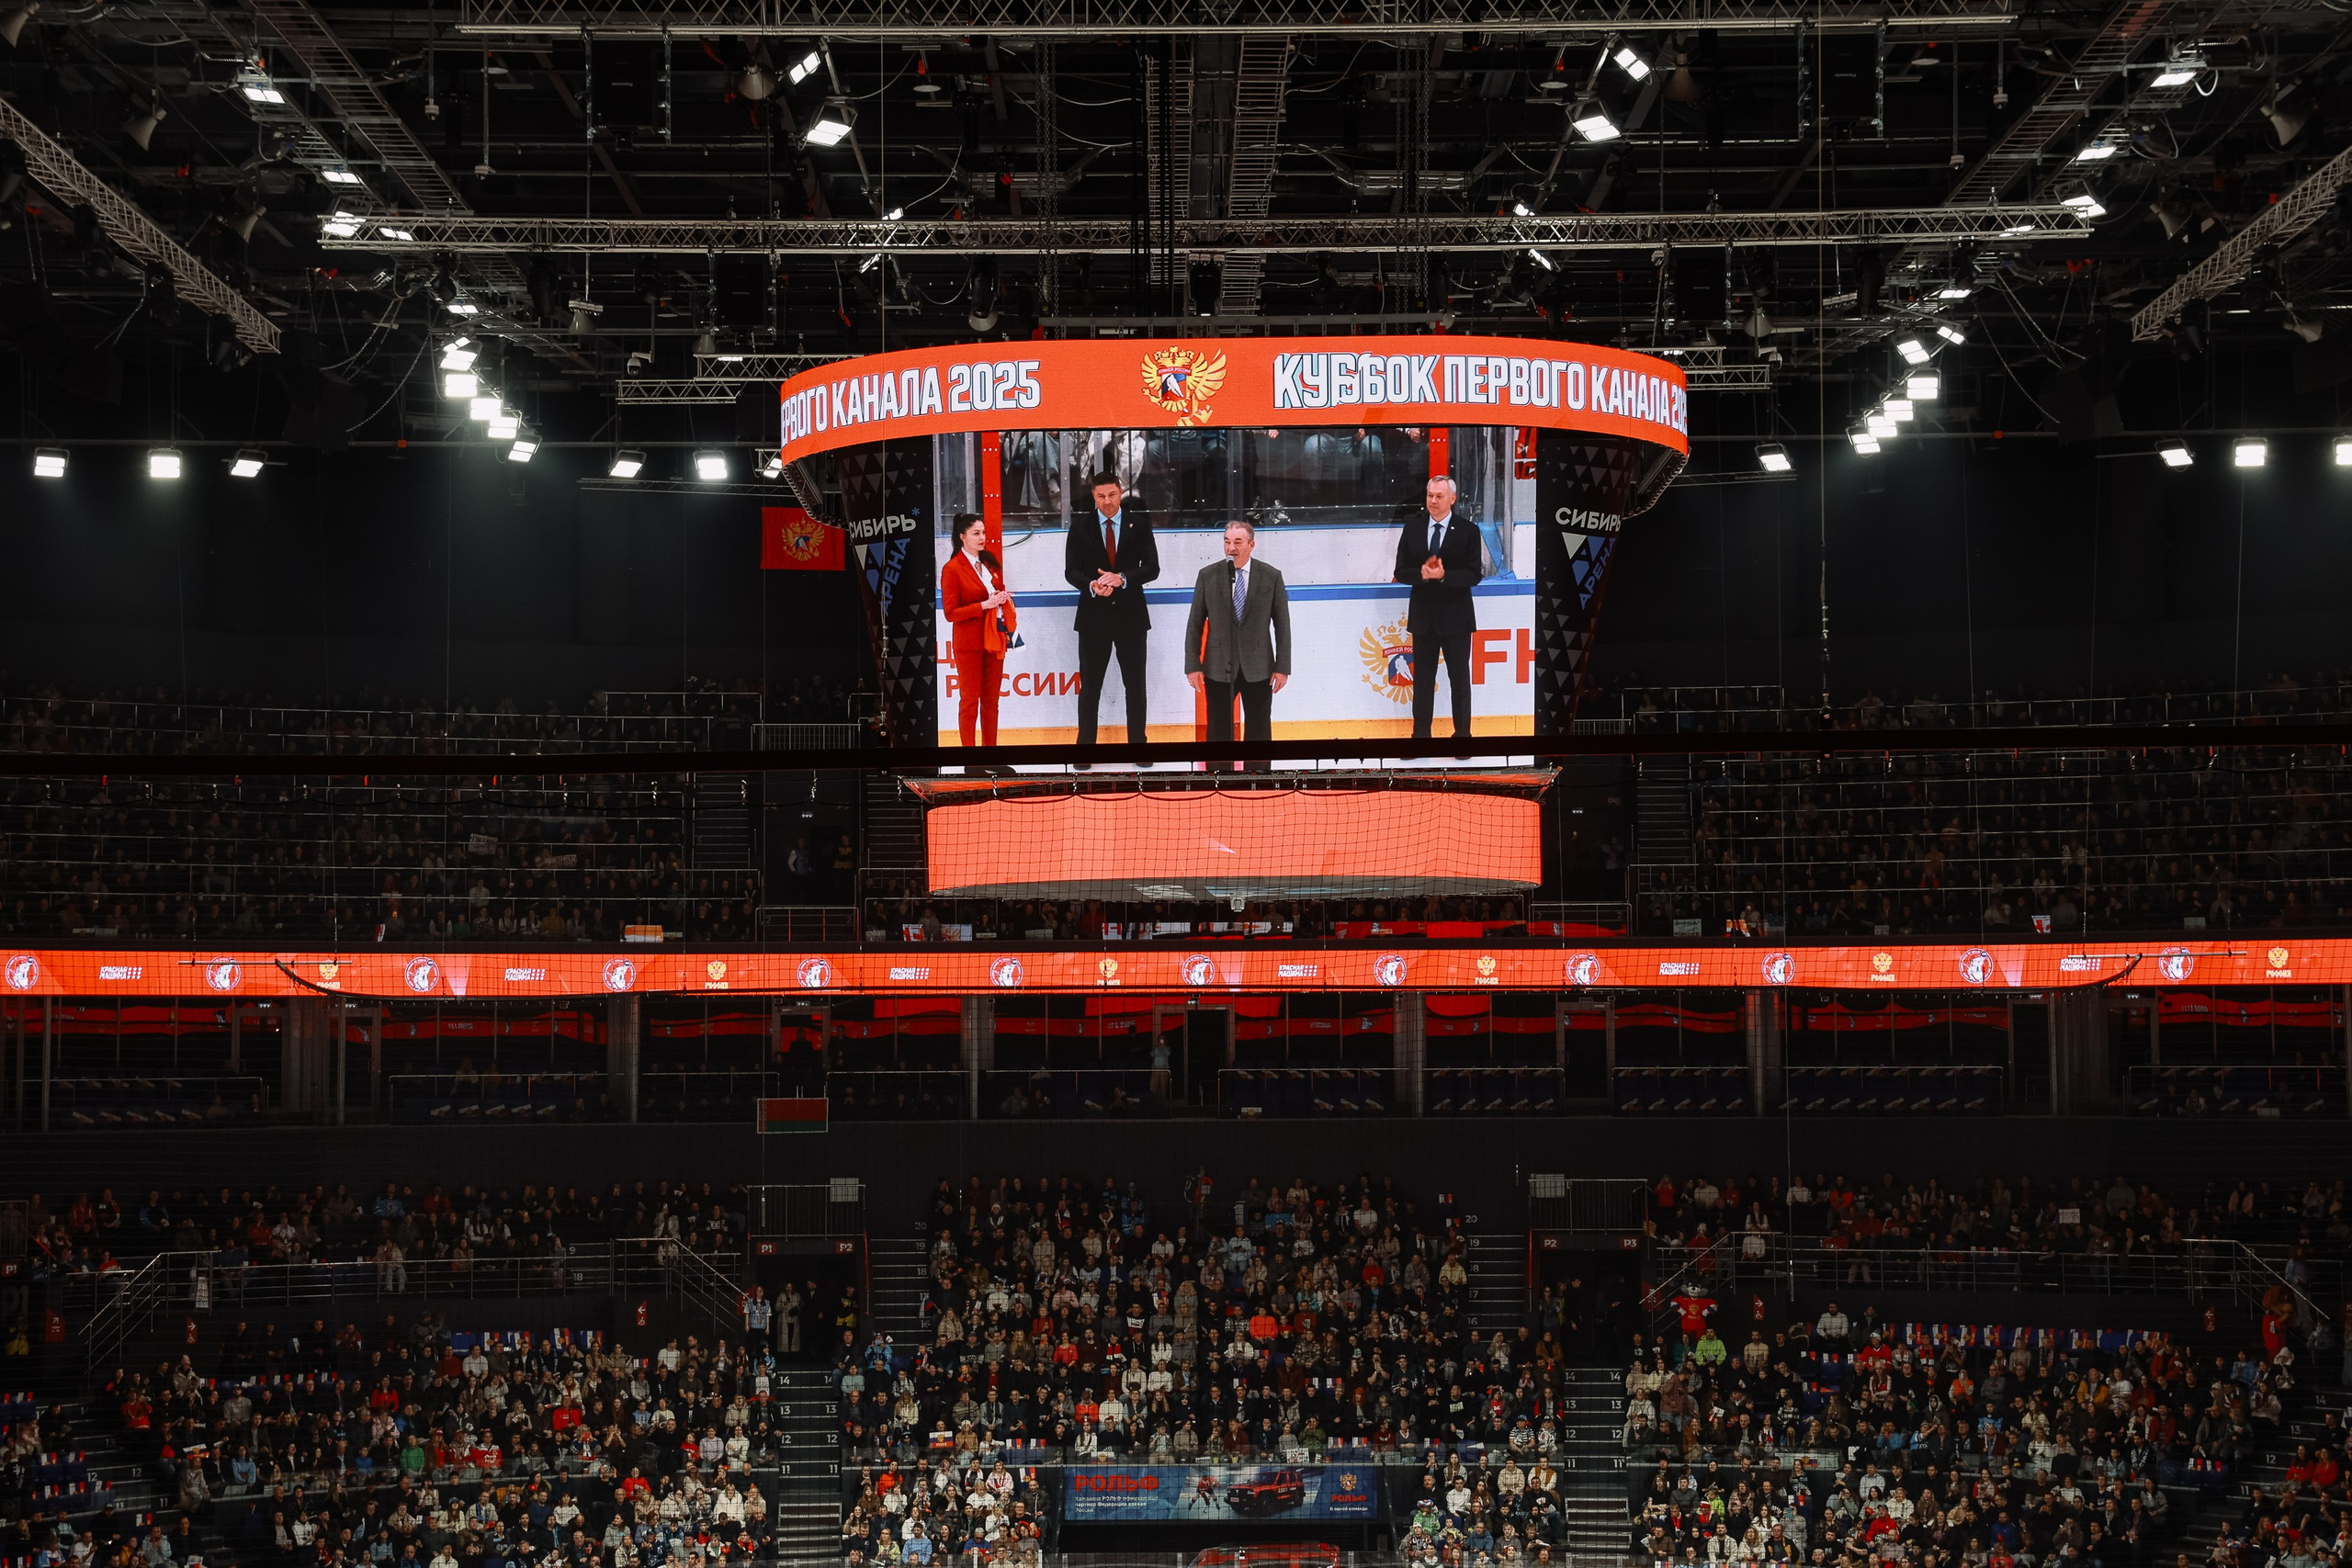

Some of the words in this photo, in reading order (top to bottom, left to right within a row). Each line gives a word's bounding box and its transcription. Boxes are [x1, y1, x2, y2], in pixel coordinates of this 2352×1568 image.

[831, 366, 944, 429] КАНАЛА
[948, 360, 1041, 413] 2025
[1443, 355, 1586, 411] ПЕРВОГО
[1590, 364, 1671, 427] КАНАЛА
[1555, 507, 1621, 532] СИБИРЬ
[848, 513, 916, 539] СИБИРЬ
[879, 537, 911, 618] АРЕНА
[1579, 537, 1616, 610] АРЕНА
[946, 672, 1081, 698] РССИИ
[1465, 1214, 1478, 1223] 20
[915, 1222, 927, 1230] 20
[916, 1242, 926, 1251] 19
[1470, 1238, 1480, 1247] 19
[1544, 1239, 1557, 1247] P2
[1624, 1239, 1637, 1247] P3
[761, 1244, 773, 1253] P1
[840, 1243, 853, 1252] P2
[6, 1264, 17, 1274] P1
[1469, 1290, 1479, 1299] 17
[920, 1320, 930, 1328] 16
[1467, 1317, 1478, 1325] 16
[780, 1376, 790, 1385] 14
[1565, 1372, 1576, 1381] 14
[1610, 1372, 1621, 1381] 14
[1566, 1400, 1576, 1409] 13
[2316, 1395, 2326, 1405] 14
[825, 1404, 837, 1414] 13
[1611, 1400, 1622, 1410] 13
[780, 1405, 791, 1415] 13
[1566, 1429, 1576, 1438] 12
[1611, 1429, 1622, 1438] 12
[2290, 1425, 2301, 1434] 13
[105, 1438, 116, 1448] 13
[781, 1435, 792, 1444] 12
[827, 1434, 838, 1443] 12
[1566, 1459, 1576, 1468] 11
[1613, 1459, 1623, 1468] 11
[2266, 1454, 2276, 1464] 12
[132, 1468, 142, 1478] 12
[781, 1465, 790, 1474] 11
[829, 1464, 838, 1473] 11
[87, 1472, 98, 1482] 12
[1075, 1474, 1159, 1492] РОЛЬФ
[2240, 1485, 2250, 1495] 11
[160, 1498, 169, 1507] 11
[1331, 1494, 1367, 1502] РОЛЬФ
